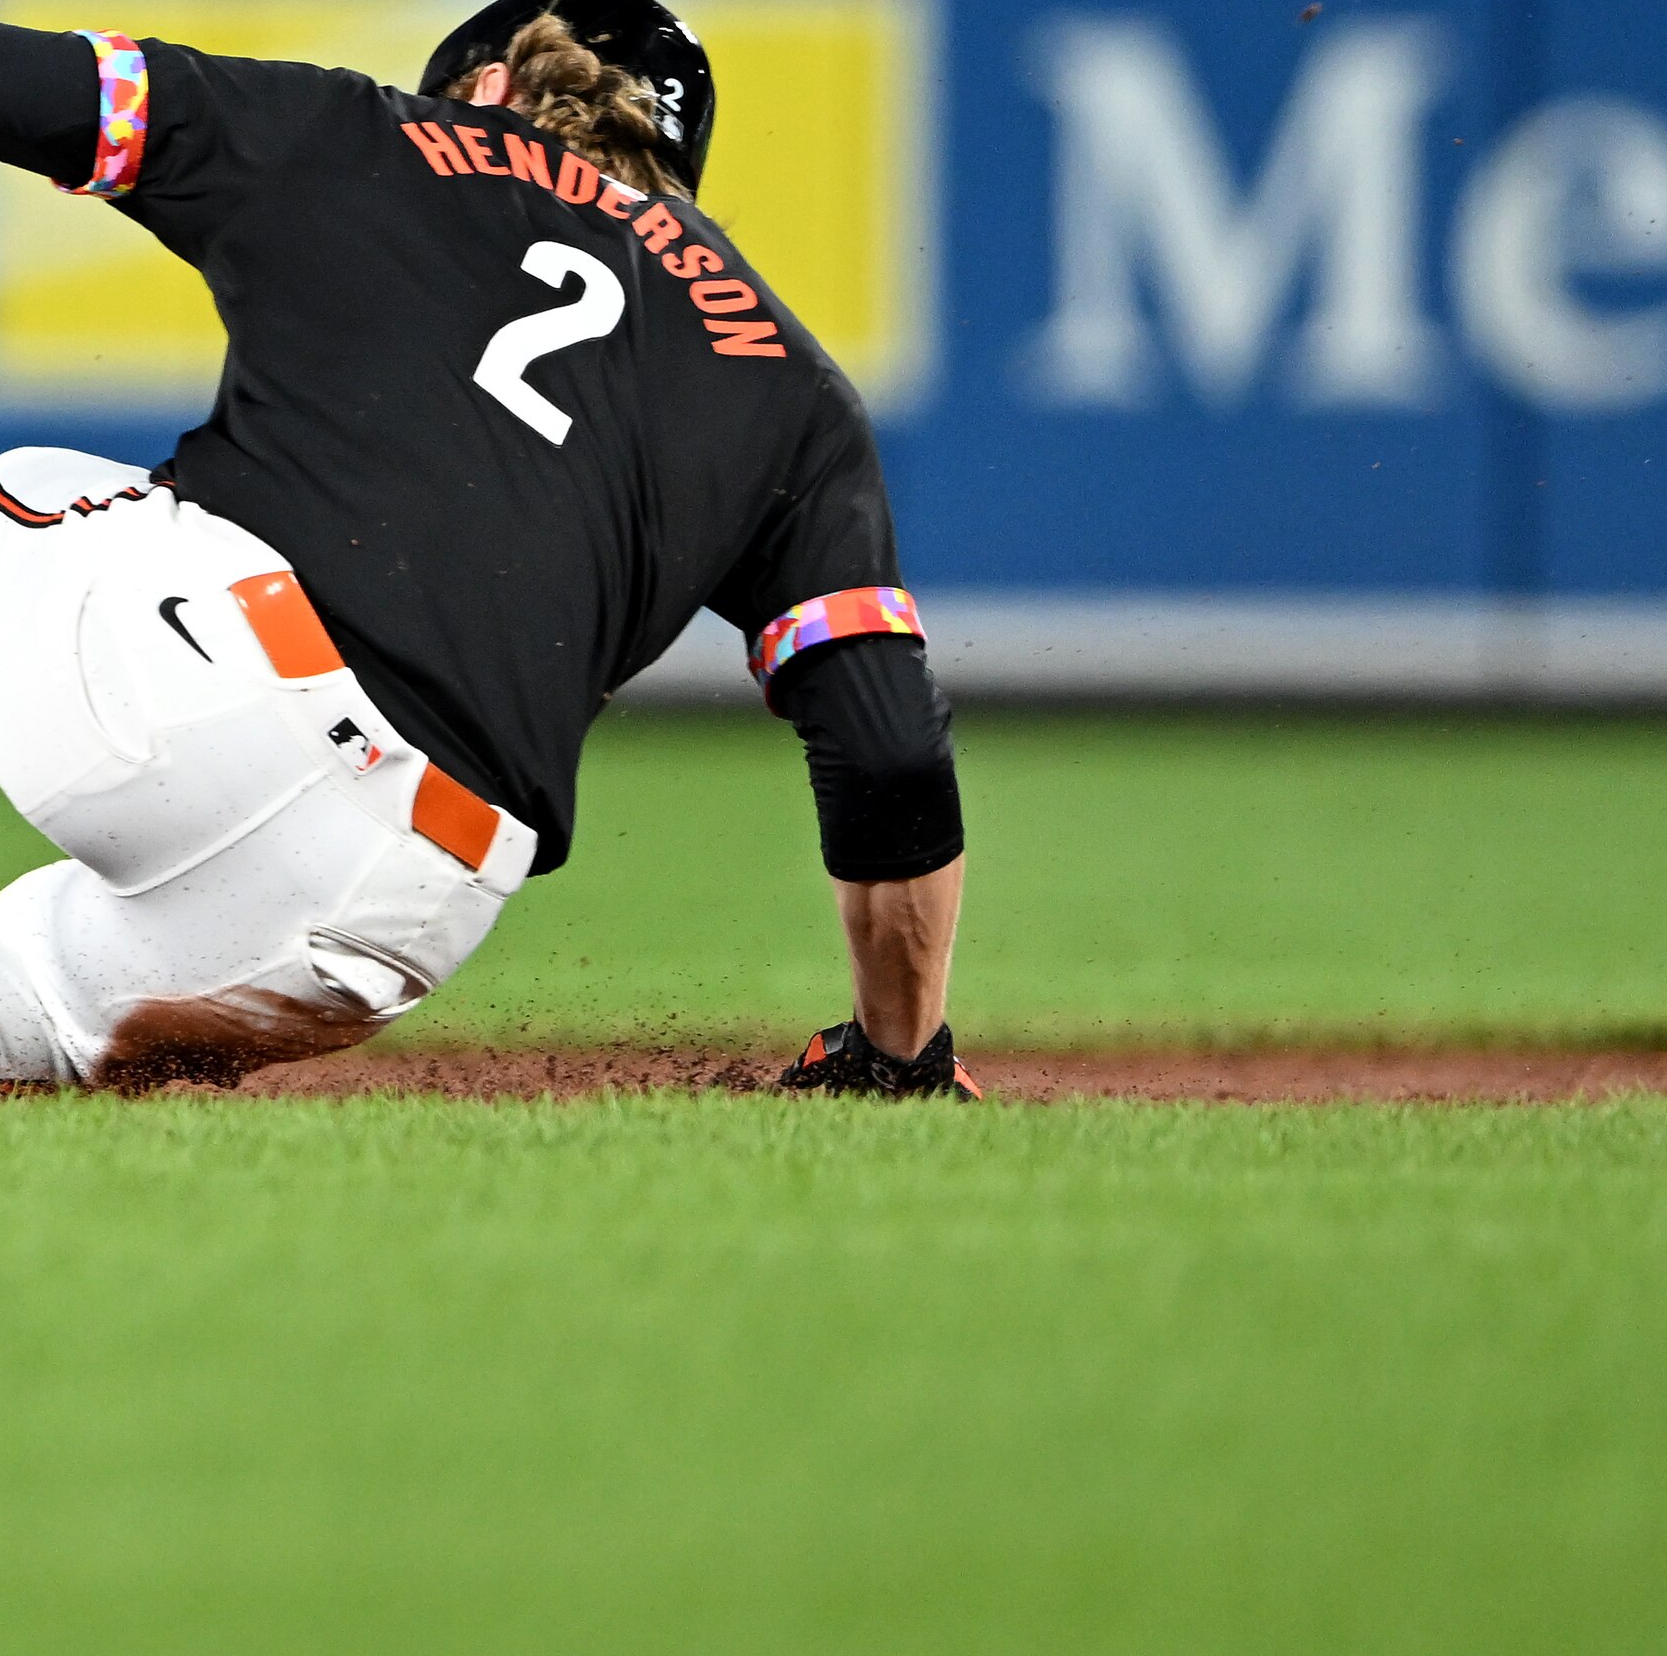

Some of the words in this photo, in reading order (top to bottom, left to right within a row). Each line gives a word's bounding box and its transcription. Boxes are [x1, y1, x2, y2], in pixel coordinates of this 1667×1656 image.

[660, 77, 685, 112] 2
[400, 120, 787, 359] HENDERSON
[1012, 12, 1667, 411] Me
[472, 240, 626, 448] 2
